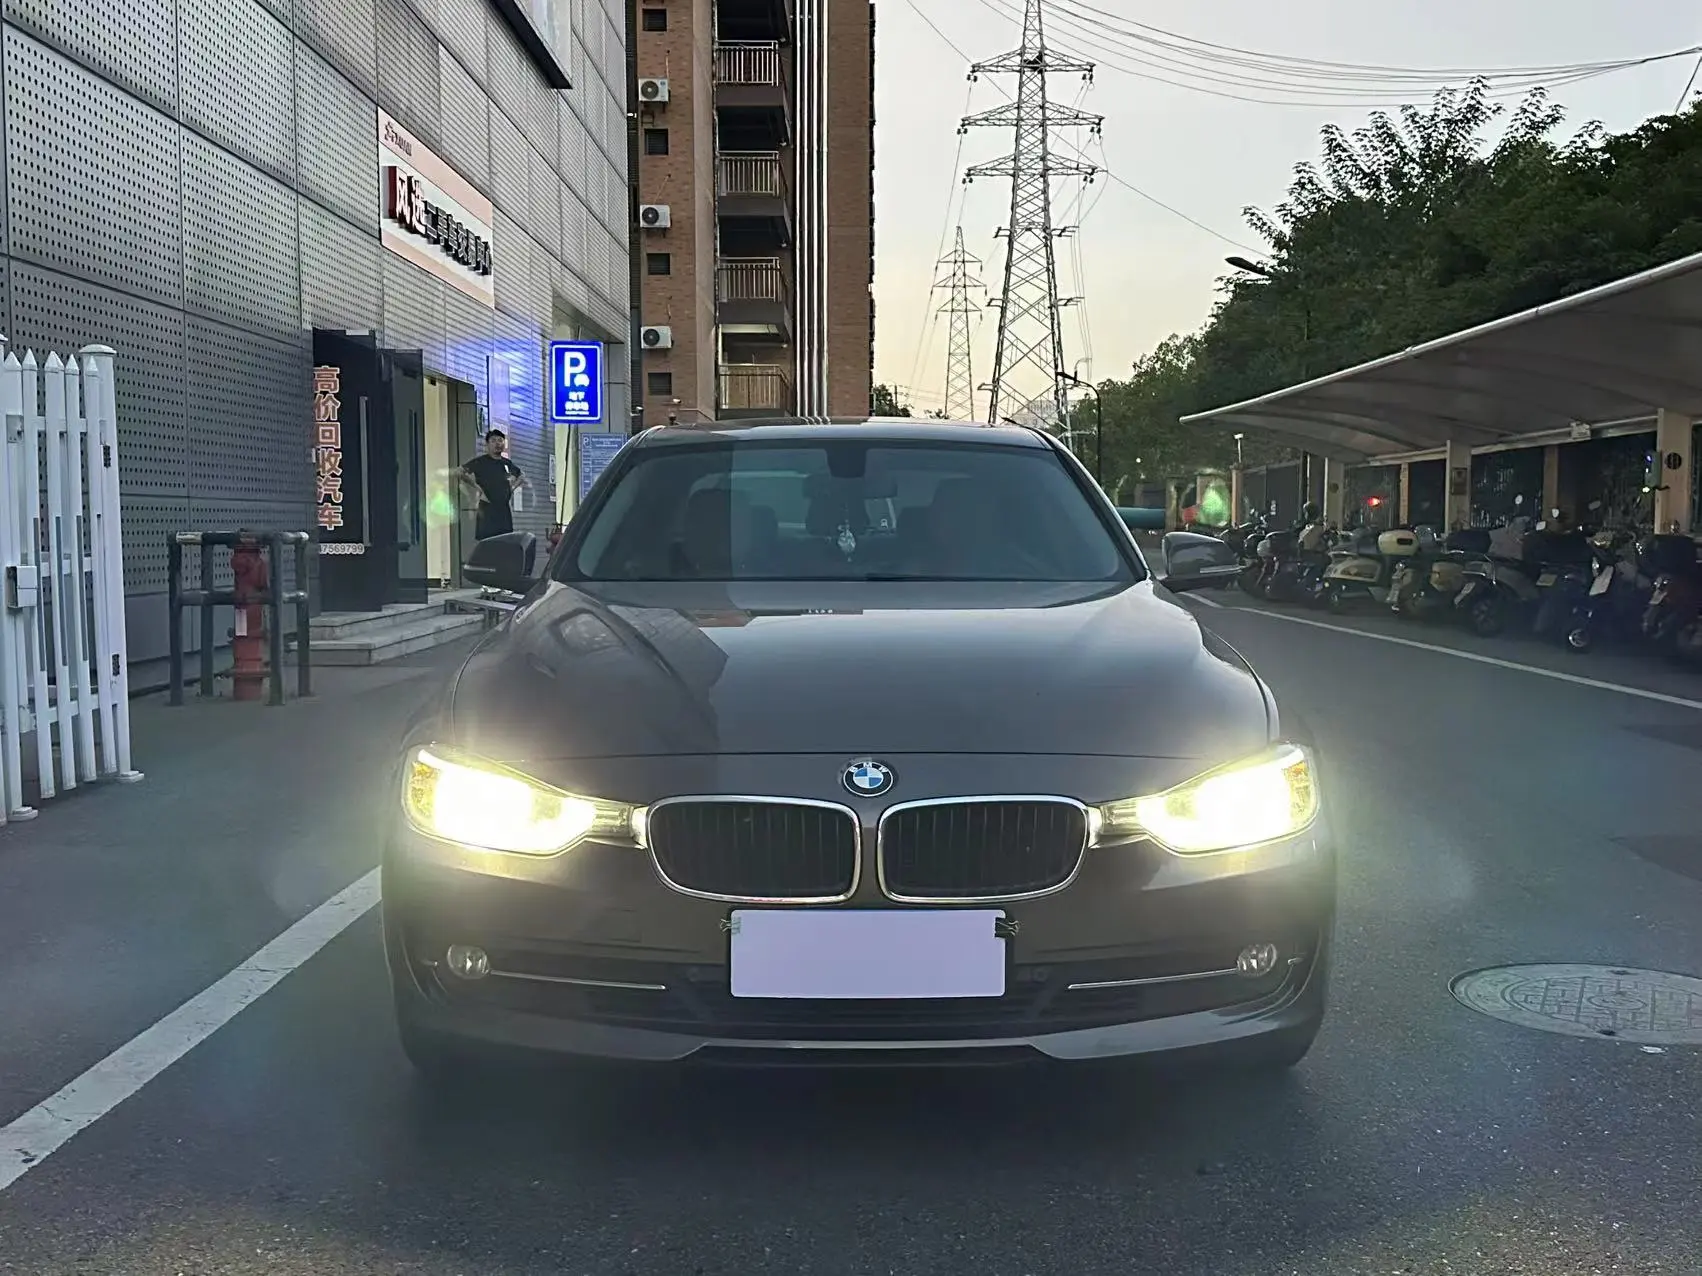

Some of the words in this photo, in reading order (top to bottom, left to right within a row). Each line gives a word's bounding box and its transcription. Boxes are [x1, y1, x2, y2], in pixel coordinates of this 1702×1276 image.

[564, 351, 586, 387] P
[314, 365, 343, 530] 高价回收汽车
[848, 761, 890, 772] BMW
